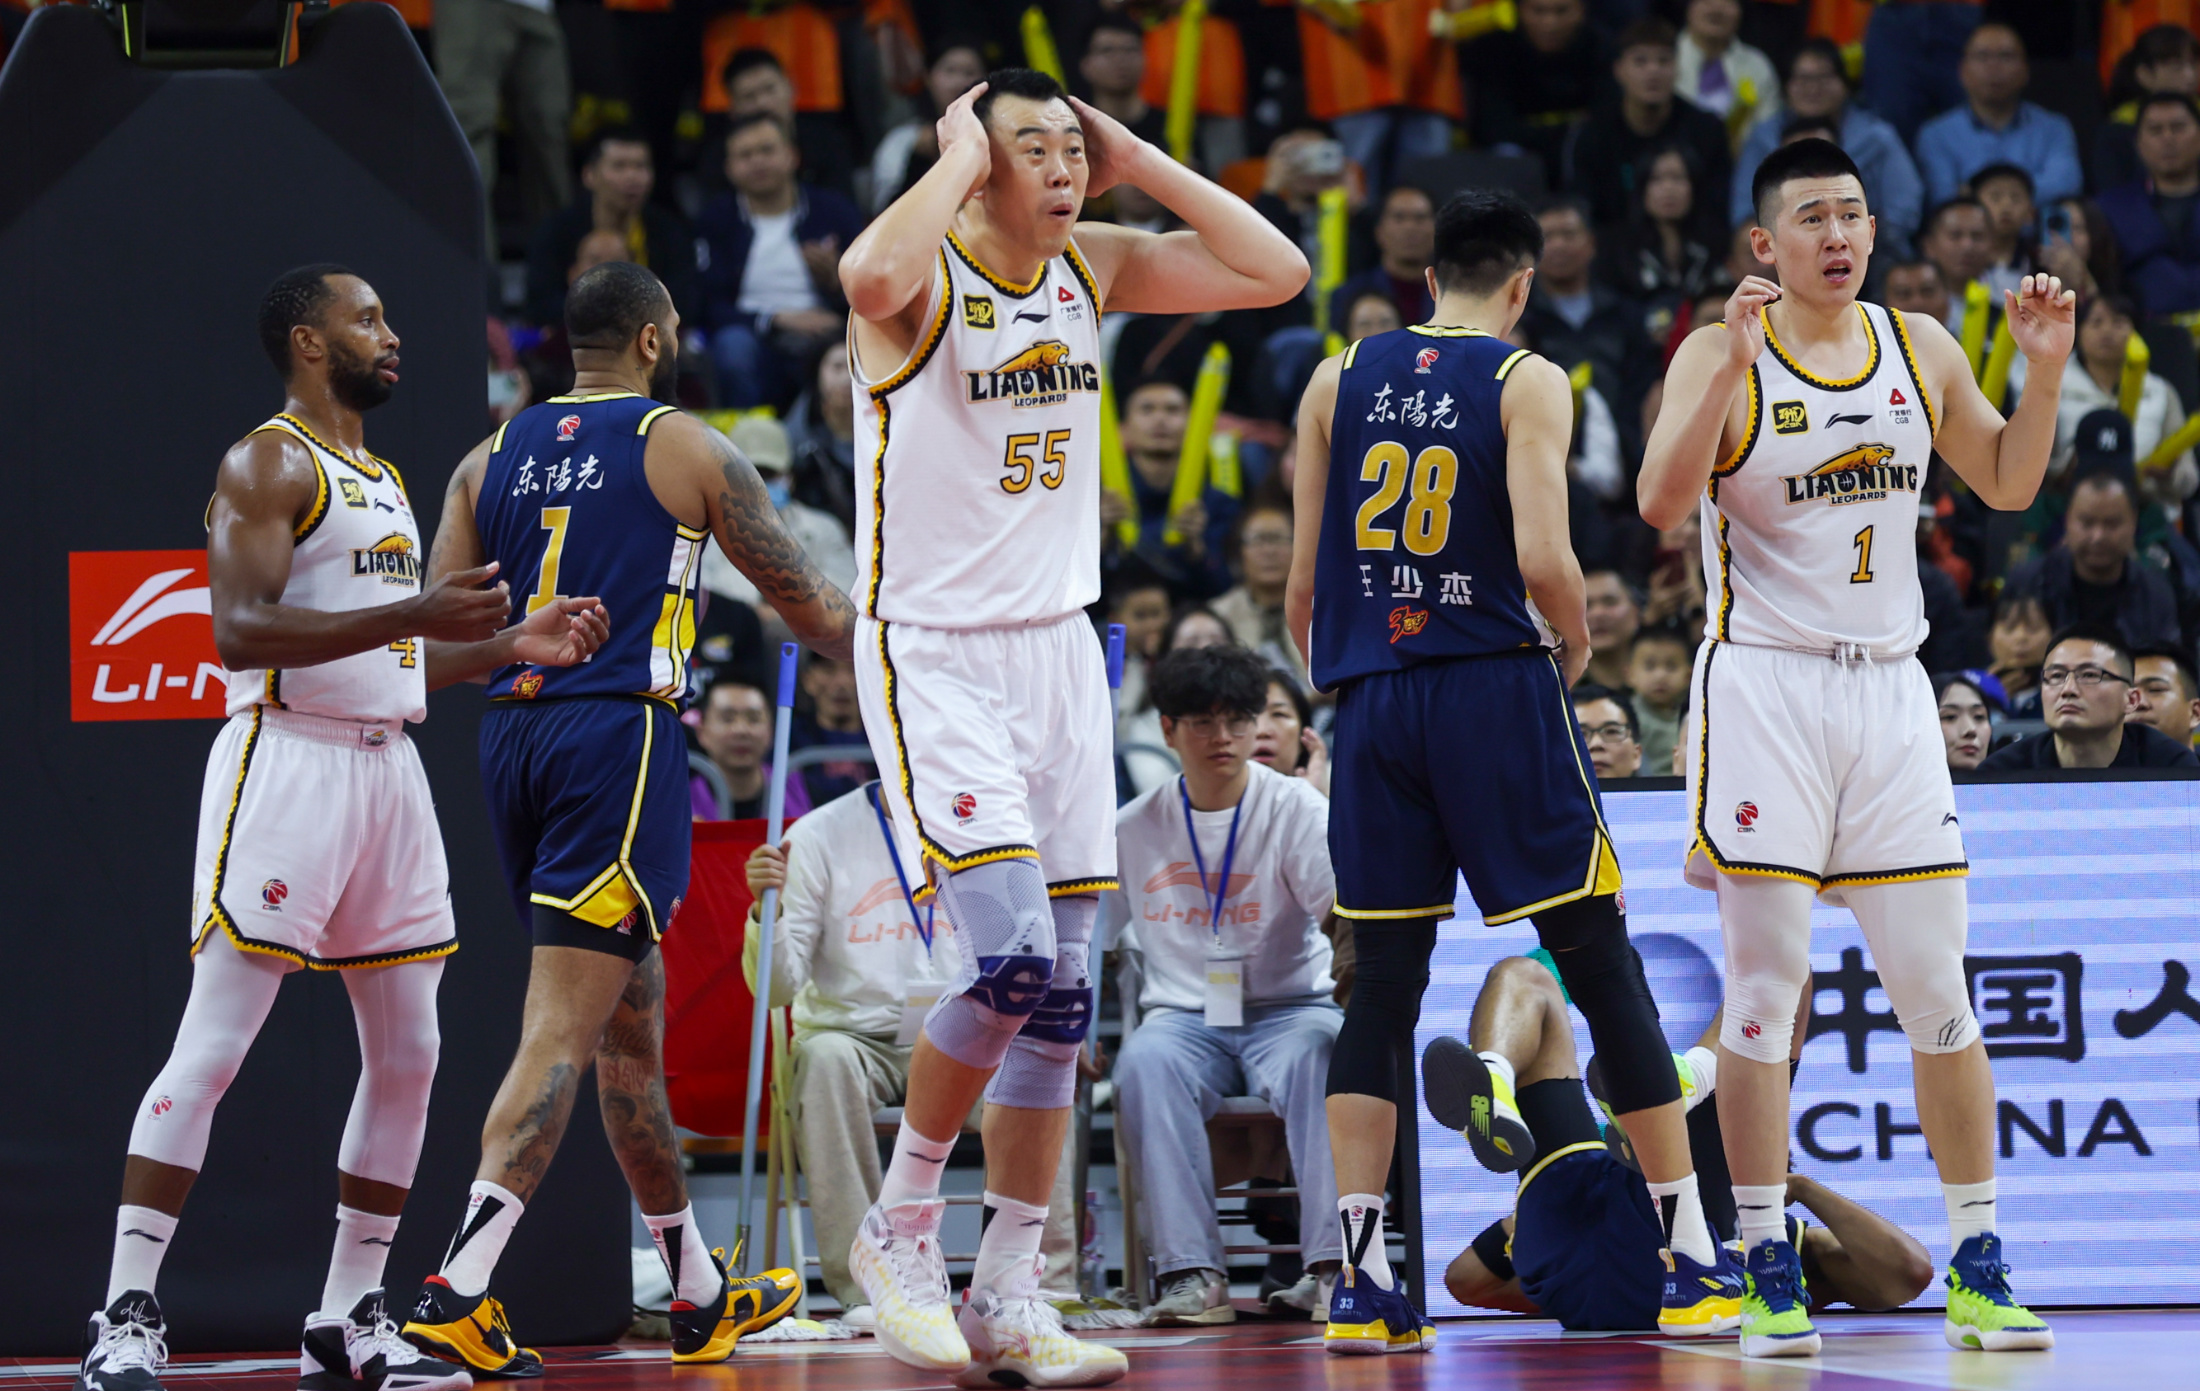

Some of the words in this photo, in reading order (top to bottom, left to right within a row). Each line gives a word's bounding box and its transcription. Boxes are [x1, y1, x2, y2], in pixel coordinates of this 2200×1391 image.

[967, 363, 1099, 401] LIAONING
[1015, 393, 1067, 407] LEOPARDS
[1000, 428, 1071, 494] 55
[1355, 441, 1459, 556] 28
[1784, 465, 1917, 502] LIAONING
[1831, 491, 1886, 504] LEOPARDS
[354, 551, 420, 578] LIAONIN
[525, 505, 571, 616] 1
[1850, 524, 1874, 584] 1
[383, 575, 414, 586] LEOPARDS
[92, 662, 228, 703] LI-N
[1143, 902, 1260, 926] LI-NNG
[1796, 1098, 2153, 1161] CHINA
[1765, 1246, 1775, 1261] S
[1339, 1297, 1354, 1309] 33
[1665, 1282, 1676, 1295] 33
